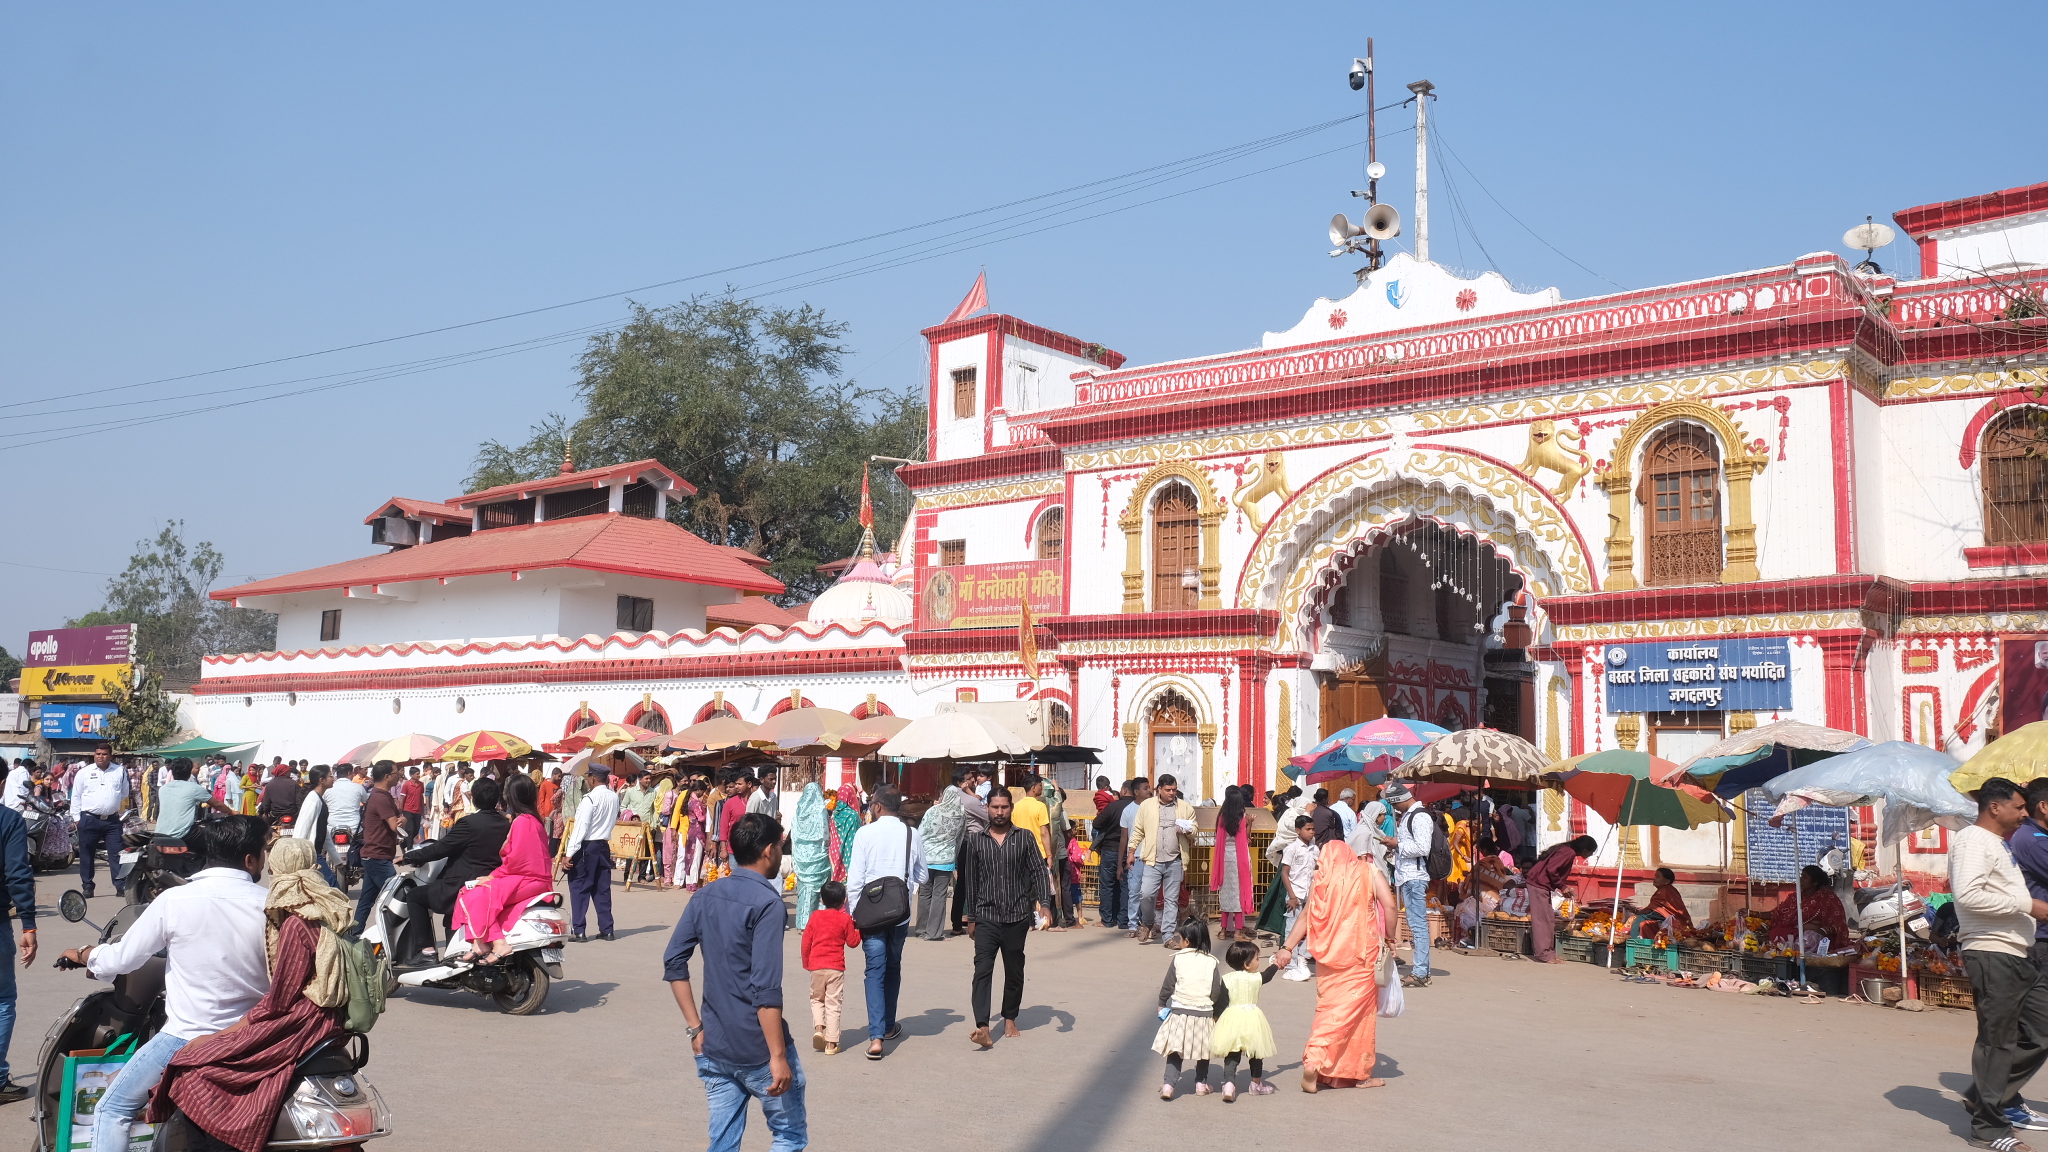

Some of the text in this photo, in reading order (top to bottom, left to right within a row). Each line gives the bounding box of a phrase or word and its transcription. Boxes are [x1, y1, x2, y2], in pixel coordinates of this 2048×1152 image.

[959, 574, 974, 601] माँ
[977, 571, 1028, 600] दन्तेश्वरी
[30, 635, 58, 660] apollo
[1667, 644, 1719, 661] कार्यालय
[43, 654, 57, 662] TYRES
[1608, 661, 1786, 684] बस्तर जिला सहकारी संघ मर्यादित
[1669, 688, 1723, 707] जगदलपुर
[75, 714, 103, 733] CEAT
